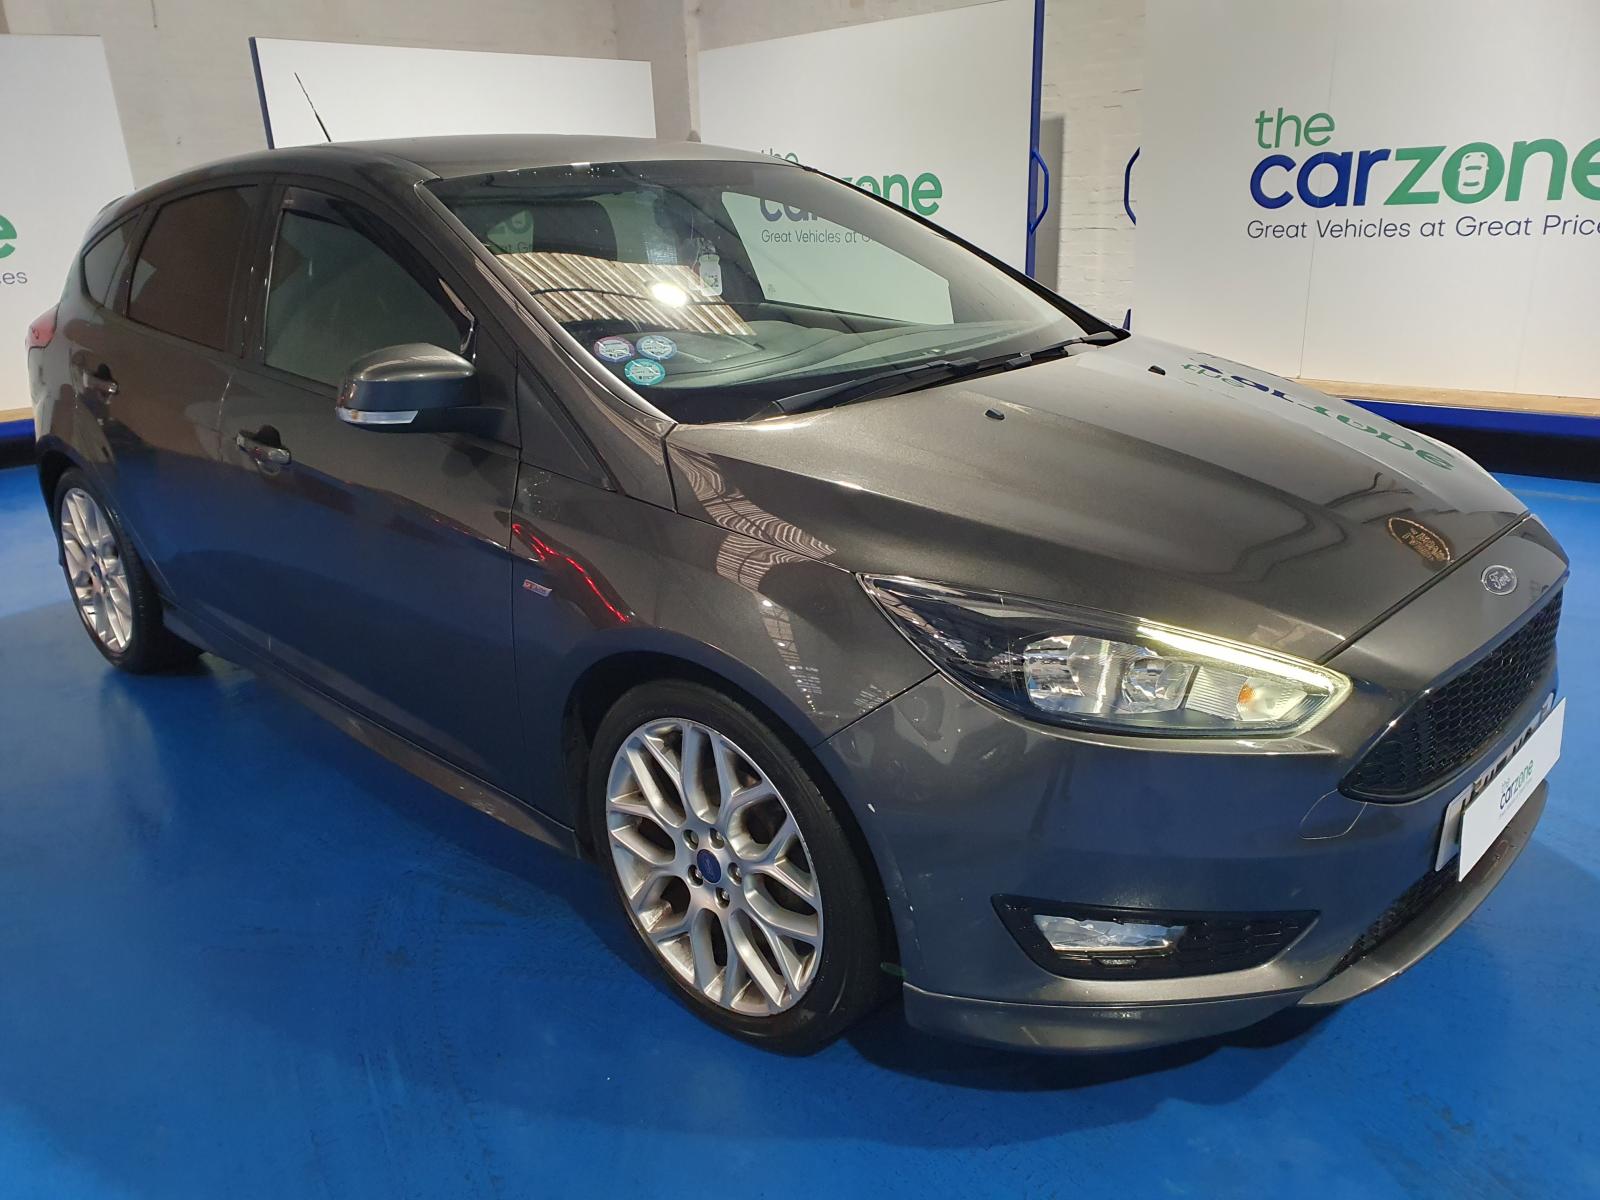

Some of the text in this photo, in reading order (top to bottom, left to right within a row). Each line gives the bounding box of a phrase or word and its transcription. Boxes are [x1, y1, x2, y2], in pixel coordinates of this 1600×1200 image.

[1255, 107, 1335, 149] the
[761, 229, 793, 243] Great
[796, 229, 841, 243] Vehicles
[1247, 214, 1600, 239] Great Vehicles at Great Pric
